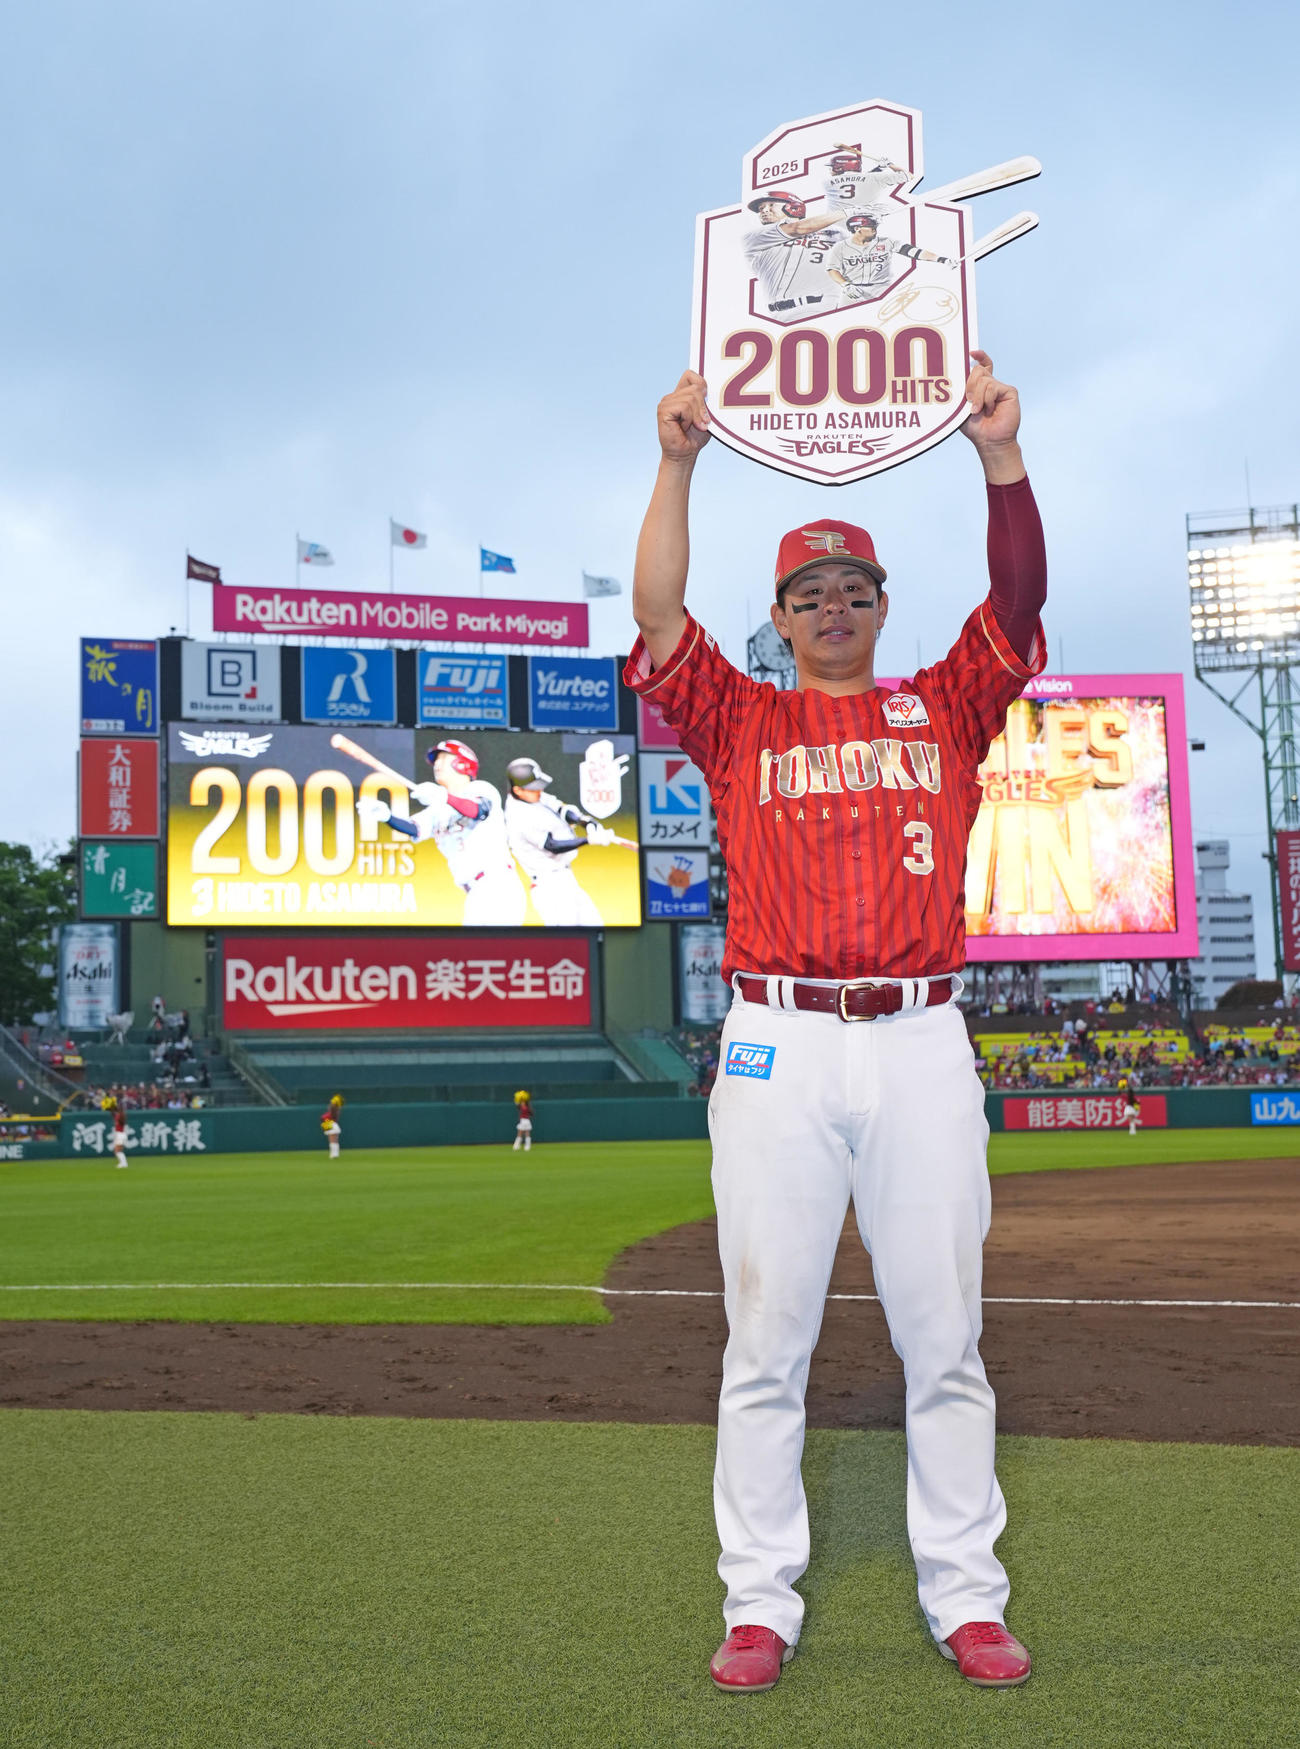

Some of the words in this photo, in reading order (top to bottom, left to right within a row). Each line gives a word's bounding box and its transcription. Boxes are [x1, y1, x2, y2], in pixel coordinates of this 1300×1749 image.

[762, 159, 799, 179] 2025
[830, 176, 867, 186] ASAMURA
[840, 184, 856, 199] 3
[809, 252, 824, 264] 3
[848, 254, 886, 266] EAGLES
[875, 264, 884, 272] 3
[719, 324, 948, 409] 2000
[890, 378, 951, 404] HITS
[750, 413, 818, 431] HIDETO
[824, 411, 921, 430] ASAMURA
[794, 440, 879, 457] EAGLES
[235, 593, 358, 629] Rakuten
[361, 601, 448, 631] Mobile
[457, 612, 502, 632] Park
[504, 613, 569, 640] Miyagi
[423, 658, 502, 693] Fuji
[536, 670, 609, 698] Yurtec
[1033, 678, 1072, 693] Vision
[190, 701, 233, 713] Bloom
[238, 701, 274, 713] Build
[887, 700, 910, 713] IRIS
[889, 718, 928, 727] アイリスオーヤマ
[107, 744, 132, 832] 大和証券
[190, 766, 411, 876] 2000
[776, 802, 925, 823] RAKUTEN
[651, 821, 701, 839] カメイ
[903, 821, 934, 875] 3
[357, 842, 415, 876] HITS
[85, 845, 154, 915] 清月記
[191, 878, 214, 917] 3
[217, 881, 301, 913] HIDETO
[306, 882, 417, 913] ASAMURA
[66, 961, 112, 980] Asahi
[225, 955, 417, 1003] Rakuten
[425, 958, 585, 1001] 楽天生命
[686, 960, 721, 977] Asah
[729, 1044, 770, 1066] Fuji
[728, 1064, 766, 1076] タイヤはフジ
[1027, 1098, 1143, 1128] 能美防災
[1255, 1096, 1300, 1121] 山九
[72, 1118, 207, 1154] 河北新報
